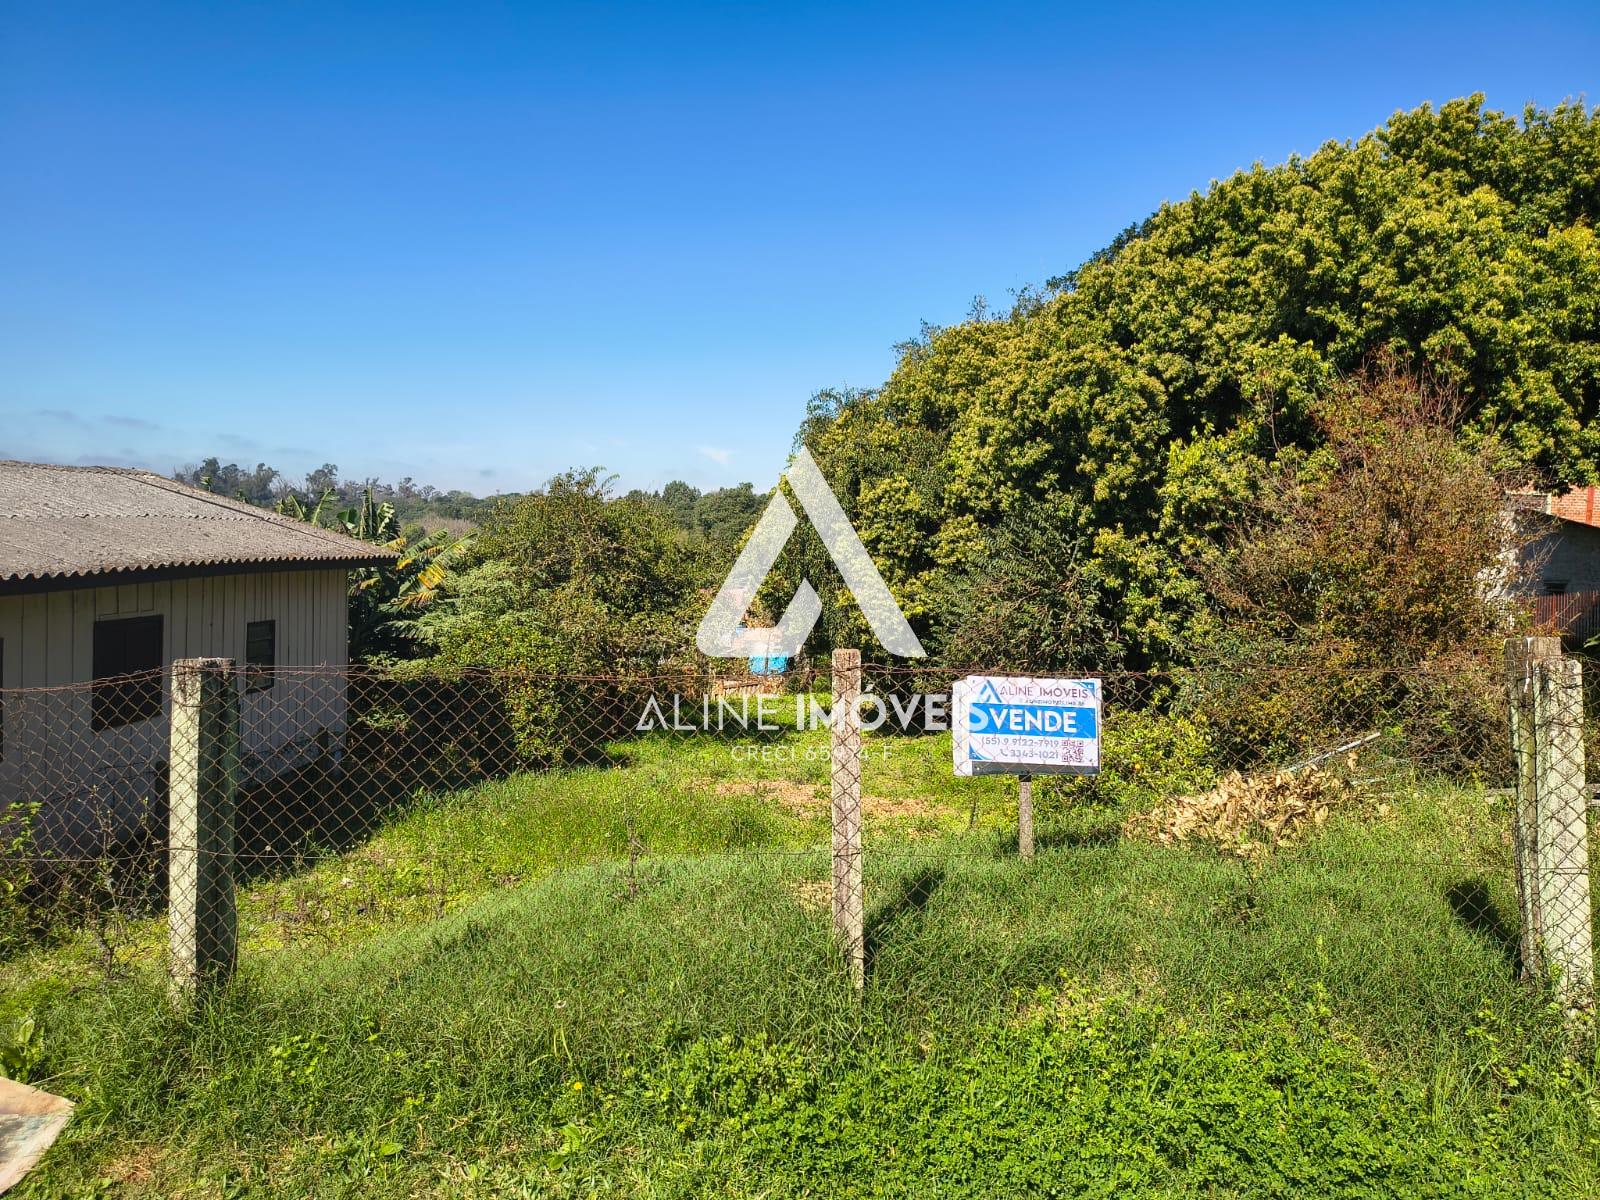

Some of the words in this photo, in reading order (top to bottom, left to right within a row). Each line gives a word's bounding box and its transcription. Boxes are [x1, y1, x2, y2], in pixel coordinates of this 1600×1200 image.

[1000, 685, 1033, 697] ALINE
[990, 707, 1078, 734] VENDE
[981, 737, 1000, 746] (55)
[1003, 737, 1009, 746] 9
[1010, 748, 1059, 759] 3343-1021
